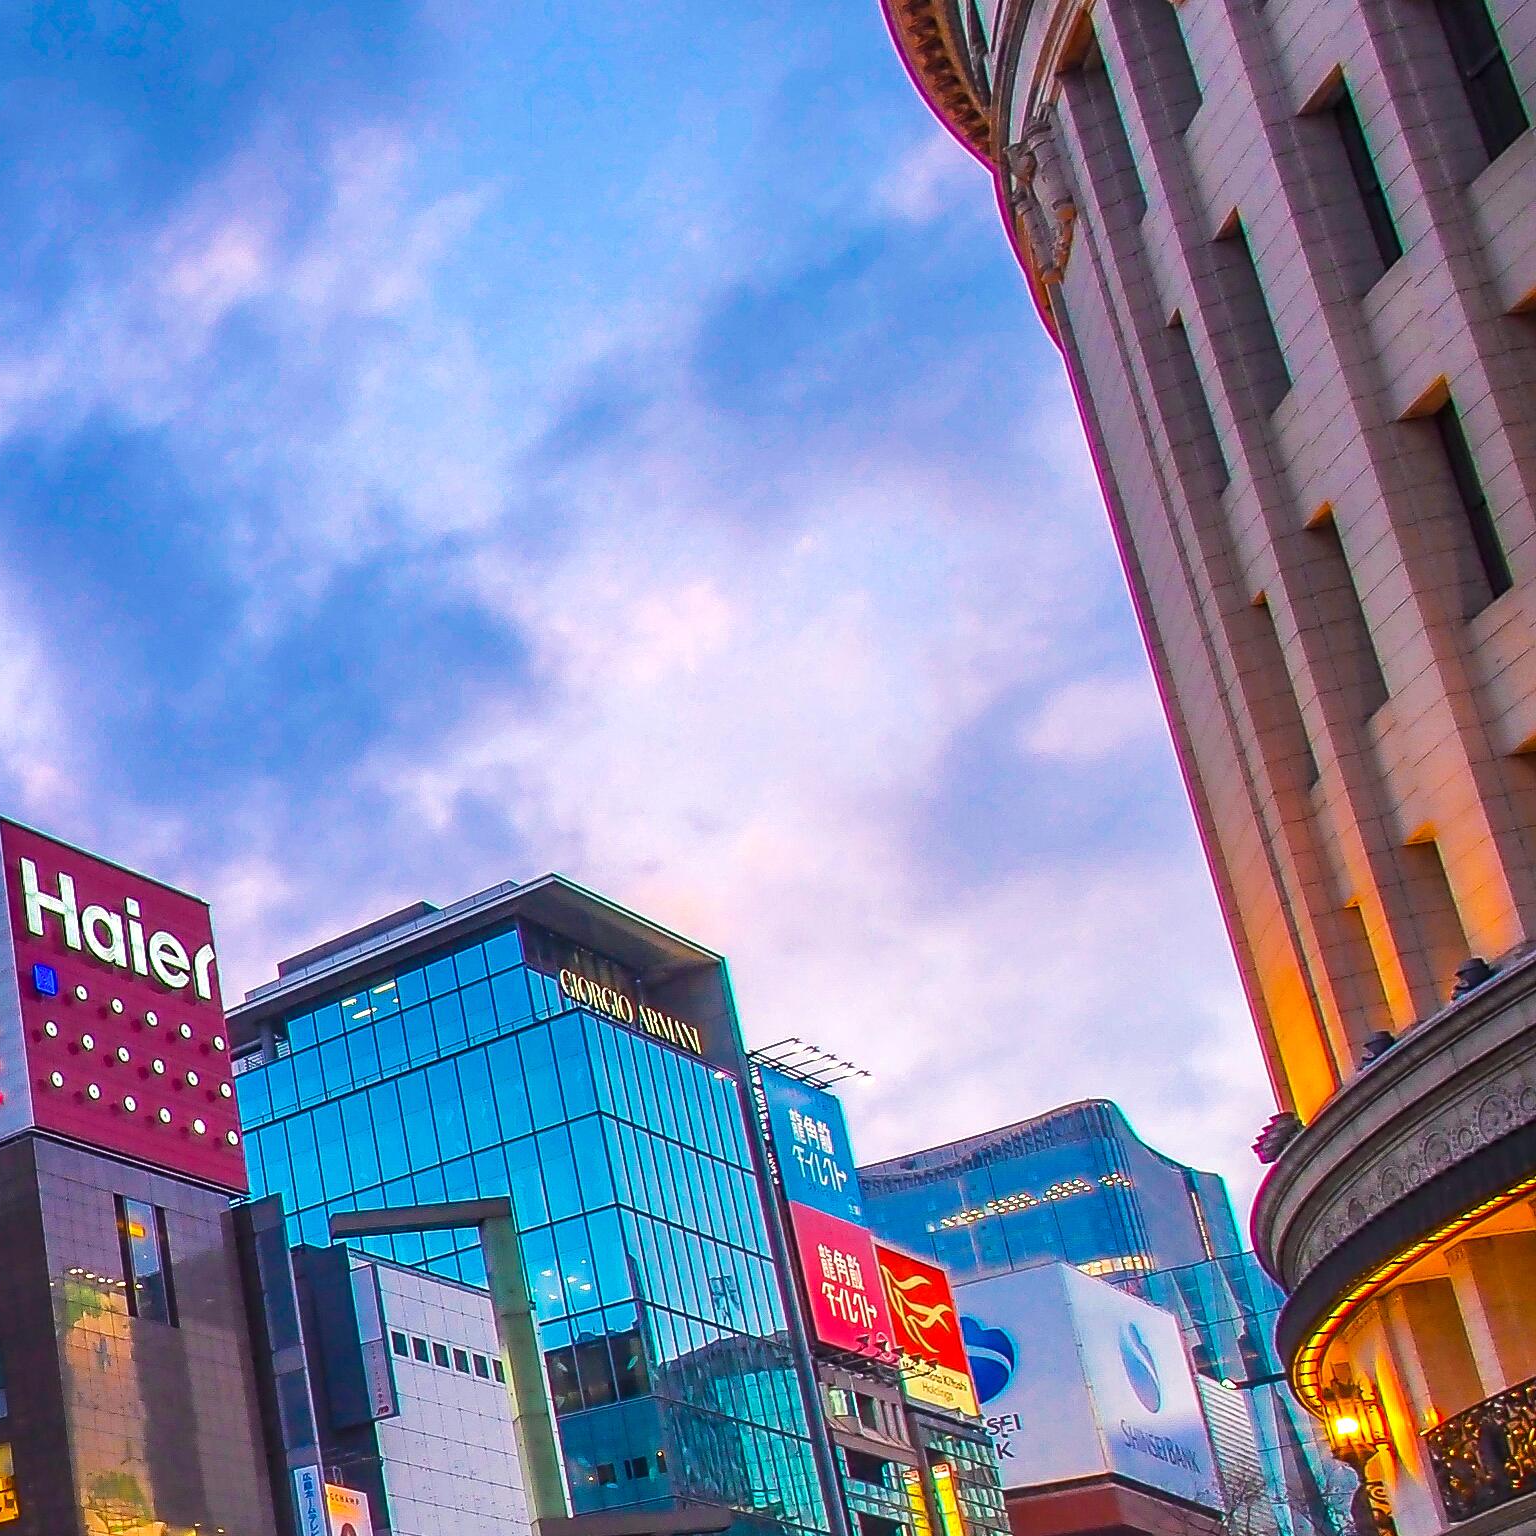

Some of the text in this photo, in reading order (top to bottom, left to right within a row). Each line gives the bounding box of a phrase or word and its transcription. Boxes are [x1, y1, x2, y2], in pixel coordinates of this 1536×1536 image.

[20, 856, 216, 1000] Haier
[559, 968, 703, 1055] GIORGIO ARMANI
[817, 1242, 865, 1292] 龍角散
[822, 1281, 878, 1329] ダイレクト
